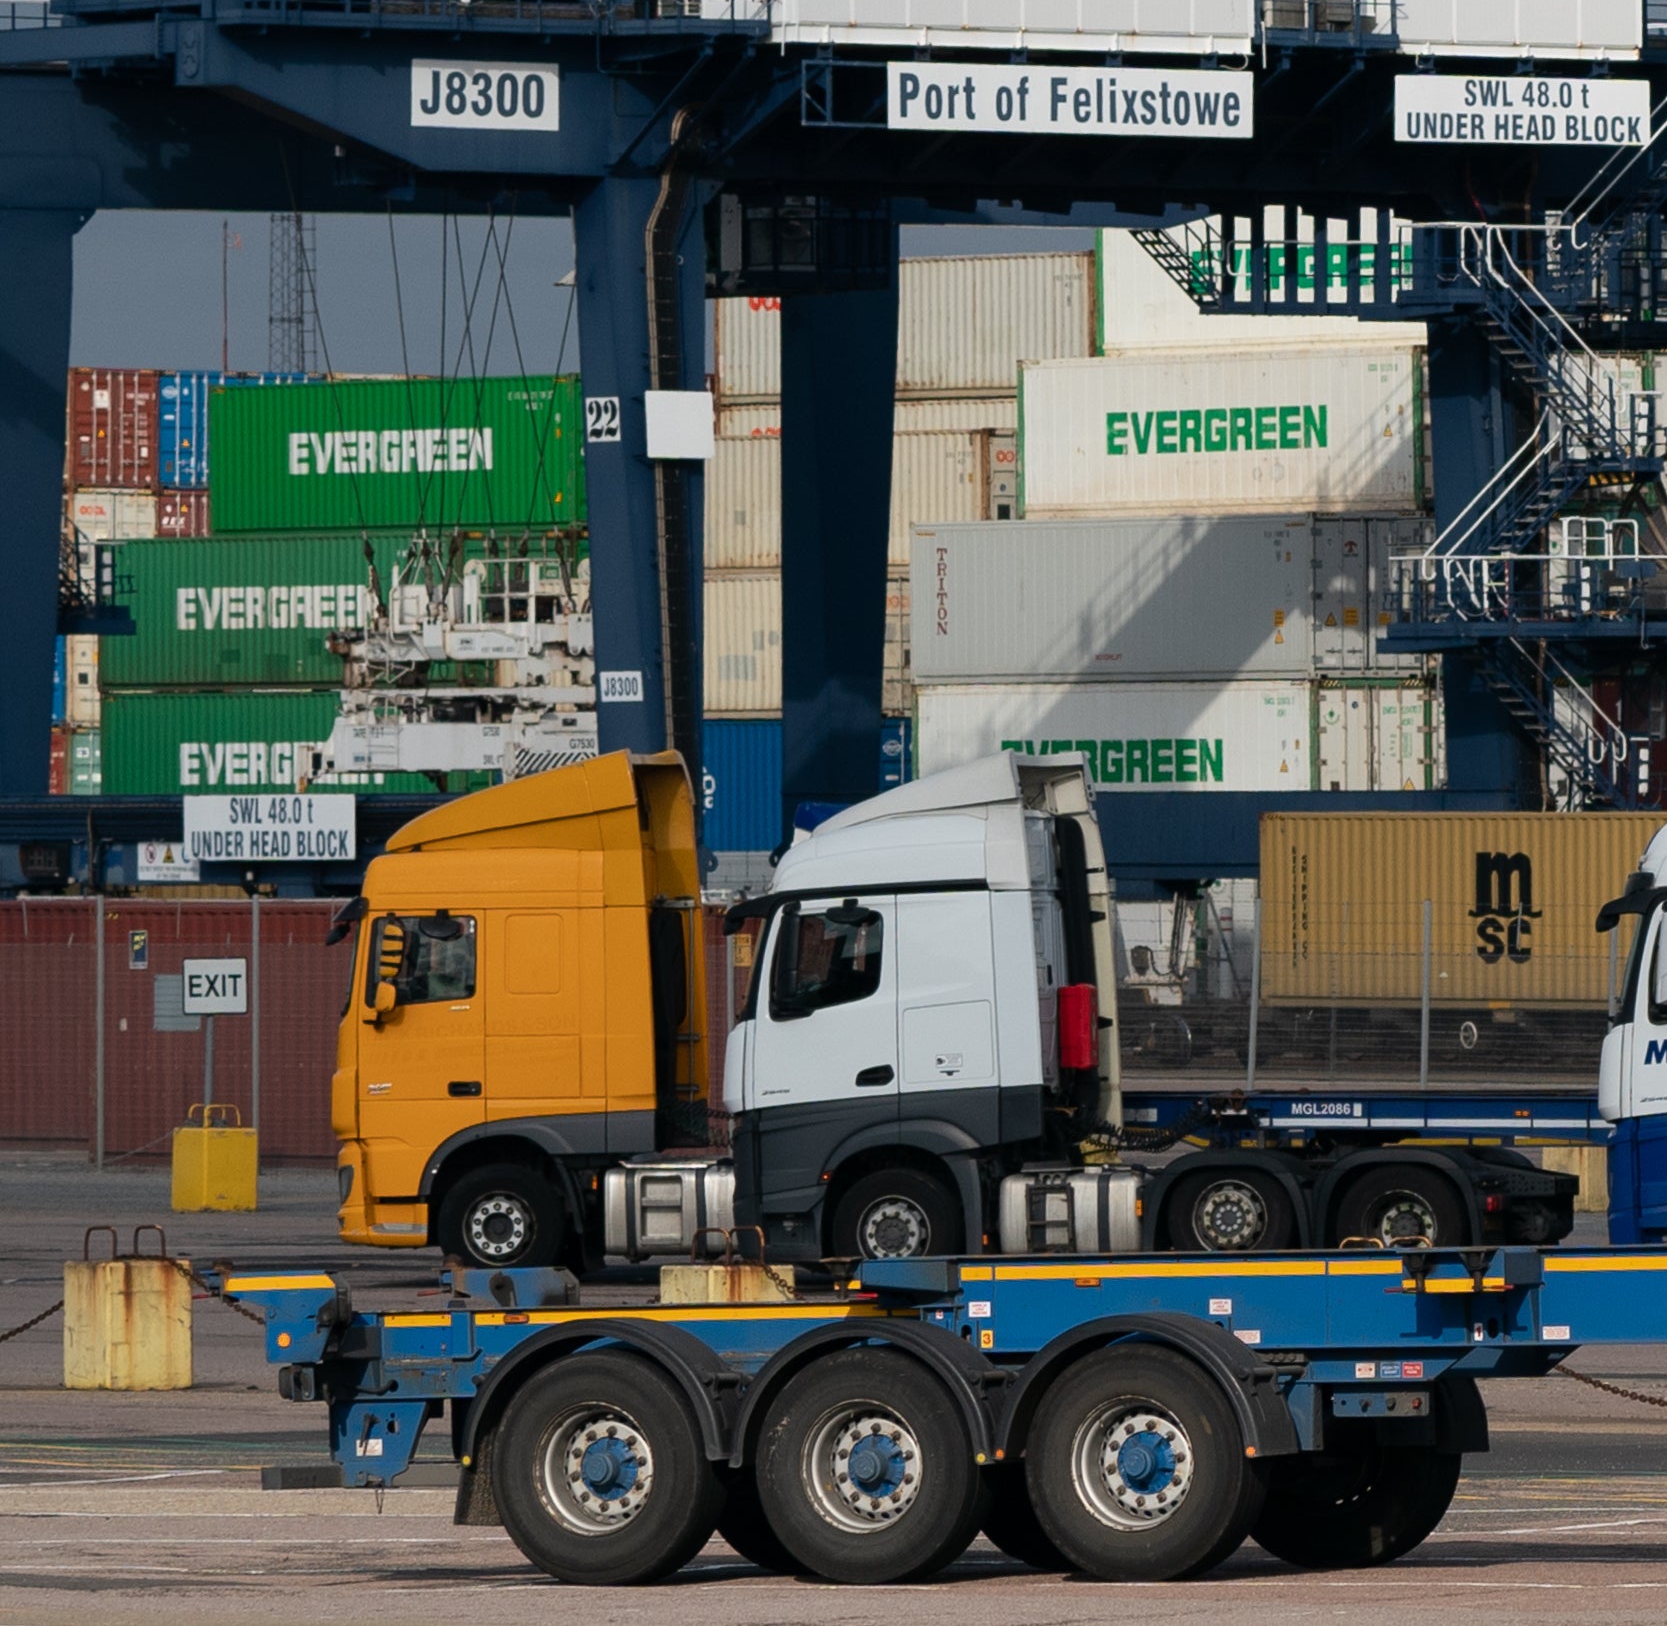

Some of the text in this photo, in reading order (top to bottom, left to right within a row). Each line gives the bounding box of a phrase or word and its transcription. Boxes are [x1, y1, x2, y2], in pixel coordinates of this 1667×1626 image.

[420, 69, 545, 119] J8300
[900, 72, 1241, 126] Port of Felixstowe
[1464, 80, 1590, 108] SWL 48.0 t
[1407, 112, 1642, 143] UNDER HEAD BLOCK
[587, 399, 617, 438] 22
[1106, 404, 1328, 456] EVERGREEN
[288, 427, 493, 475] EVERGREEN
[936, 547, 948, 636] TRITON
[603, 677, 639, 697] J8300
[569, 738, 596, 750] G7530
[230, 798, 314, 824] SWL 48.0 t
[191, 829, 349, 858] UNDER HEAD BLOCK
[188, 974, 242, 998] EXIT
[1291, 1103, 1351, 1116] MGL2086
[982, 1331, 992, 1346] 3
